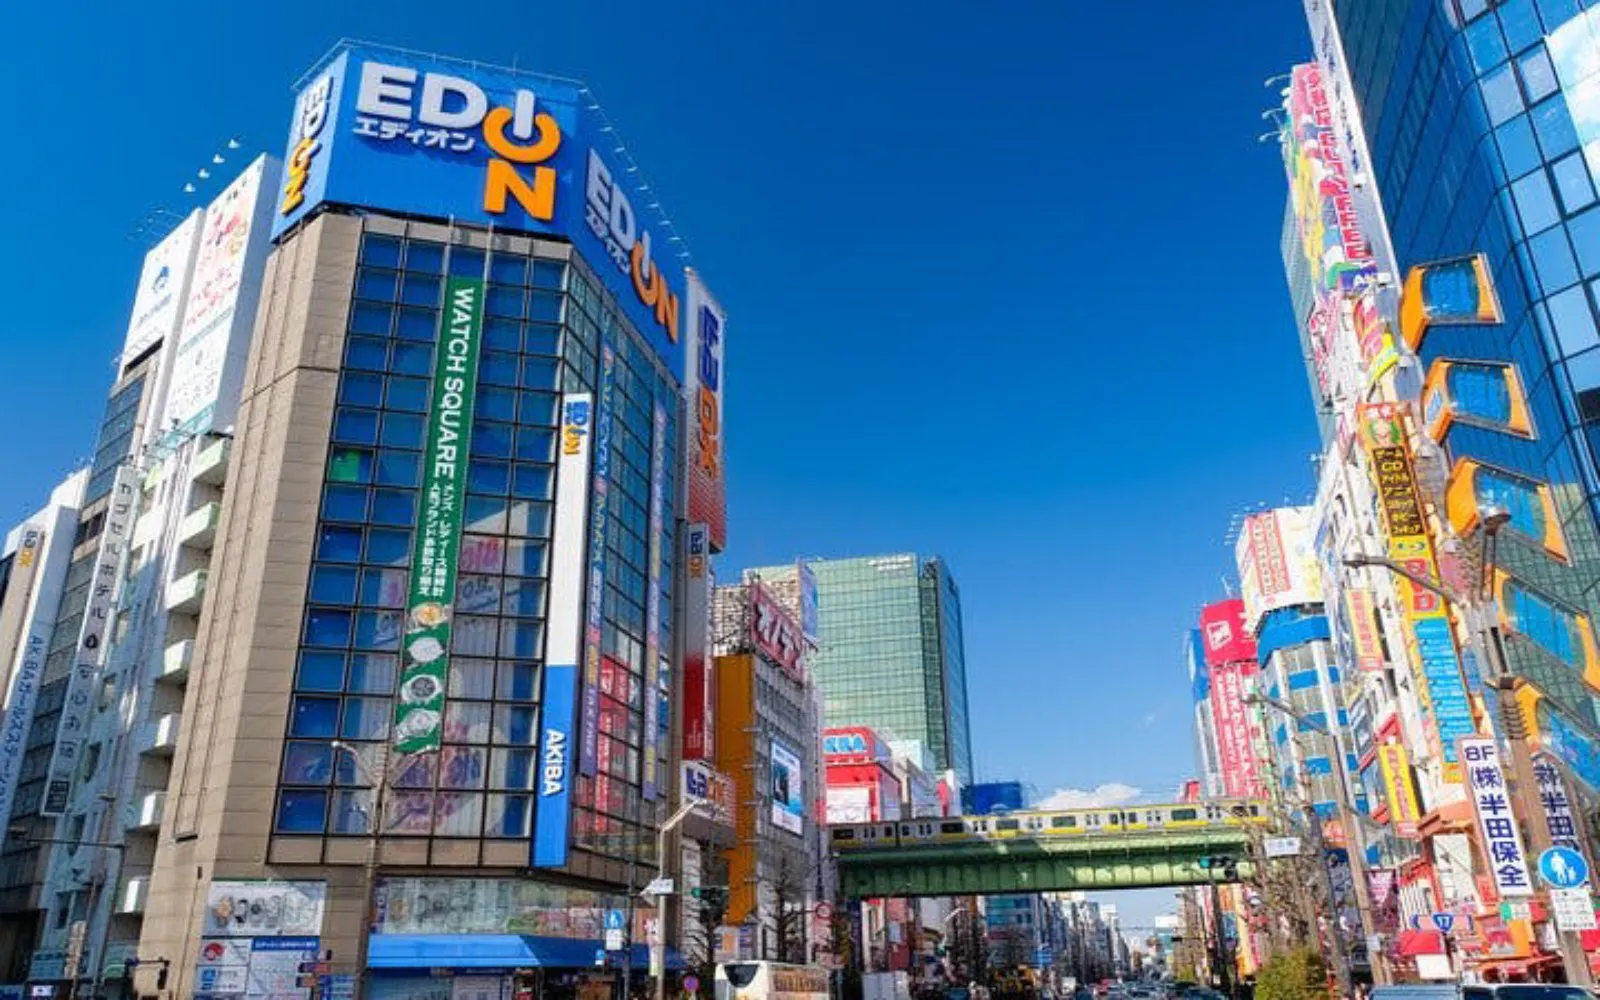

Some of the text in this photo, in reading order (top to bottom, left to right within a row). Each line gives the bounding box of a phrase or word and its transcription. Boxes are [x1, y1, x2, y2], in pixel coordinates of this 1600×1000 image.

[352, 116, 477, 152] エディオン
[355, 61, 562, 221] EDION
[434, 287, 475, 479] WATCH SQUARE
[542, 729, 566, 797] AKIBA
